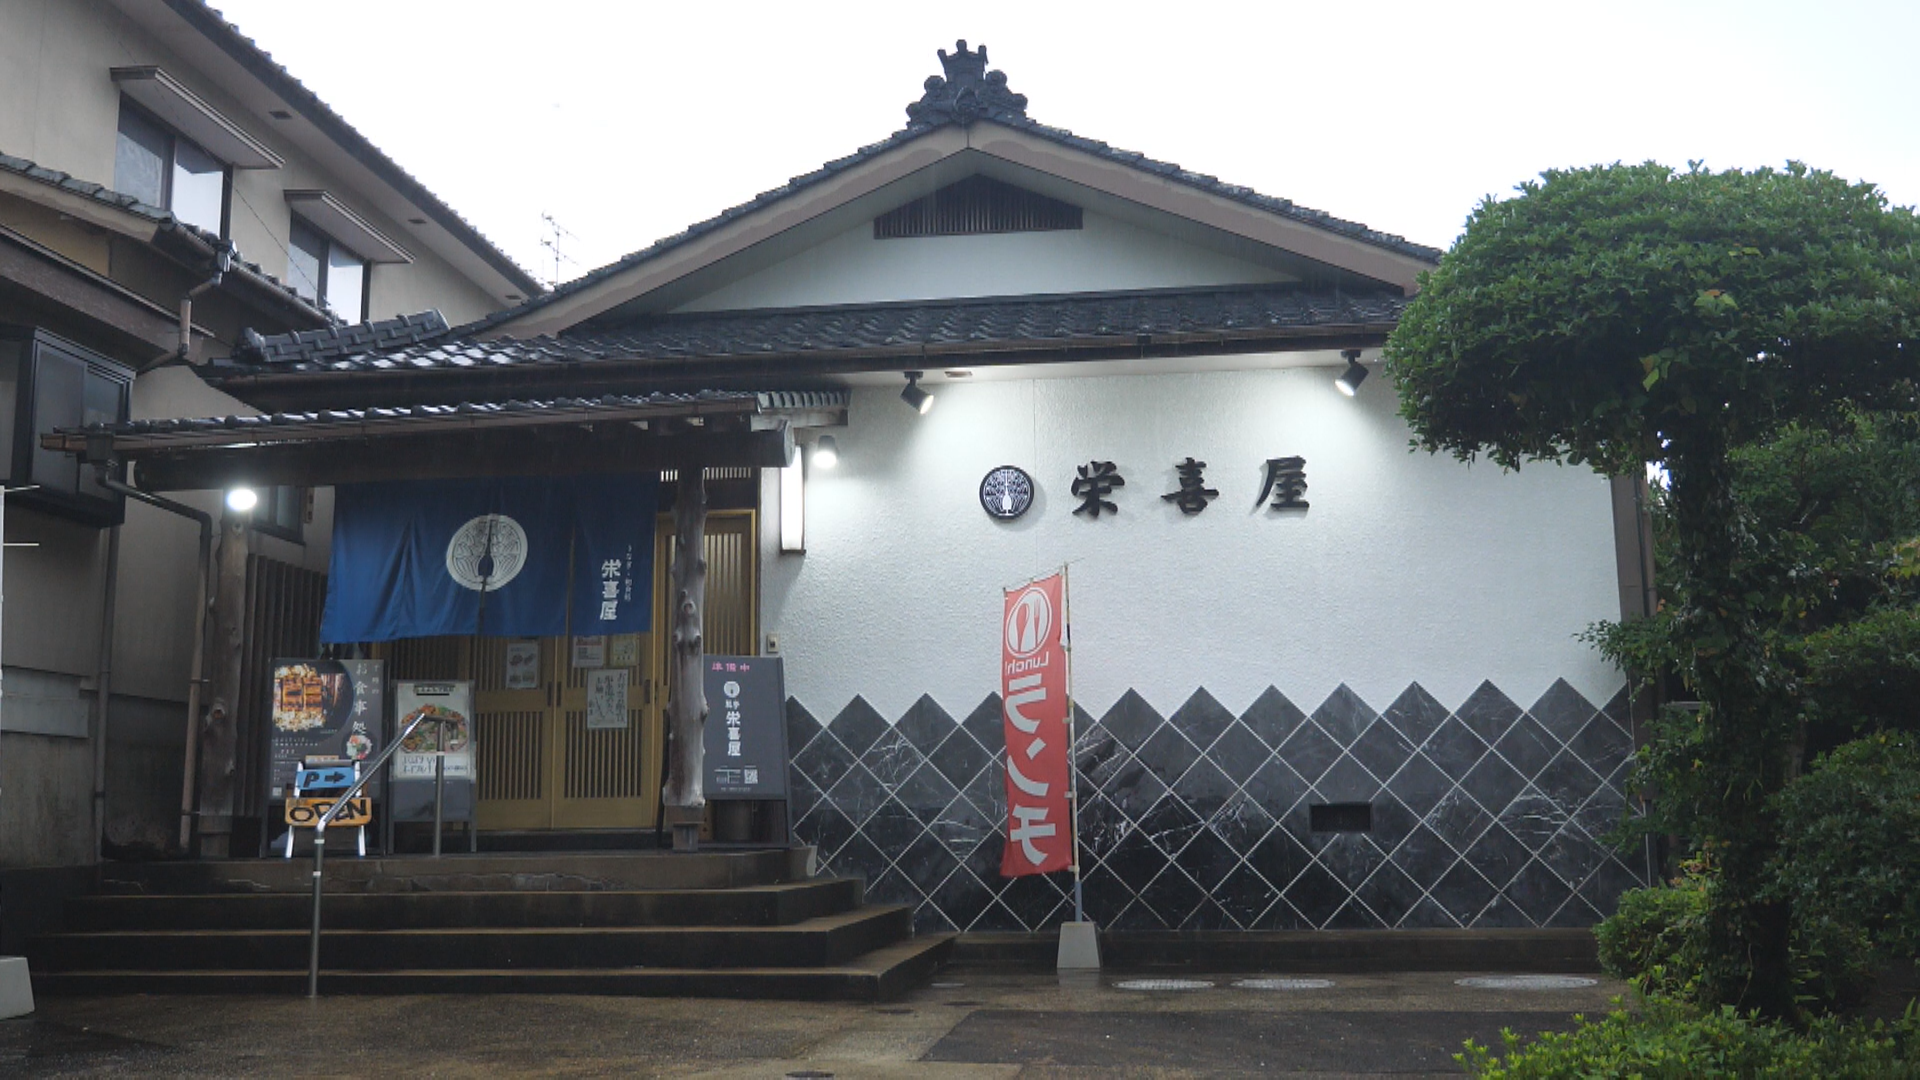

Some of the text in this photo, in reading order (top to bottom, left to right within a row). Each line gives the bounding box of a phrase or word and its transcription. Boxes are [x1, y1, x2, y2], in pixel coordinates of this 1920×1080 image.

[1071, 455, 1310, 517] 栄喜屋
[600, 558, 622, 621] 栄喜屋
[712, 661, 750, 675] 準備中
[352, 663, 368, 734] お食事処
[726, 711, 742, 757] 栄喜屋
[303, 771, 320, 788] P
